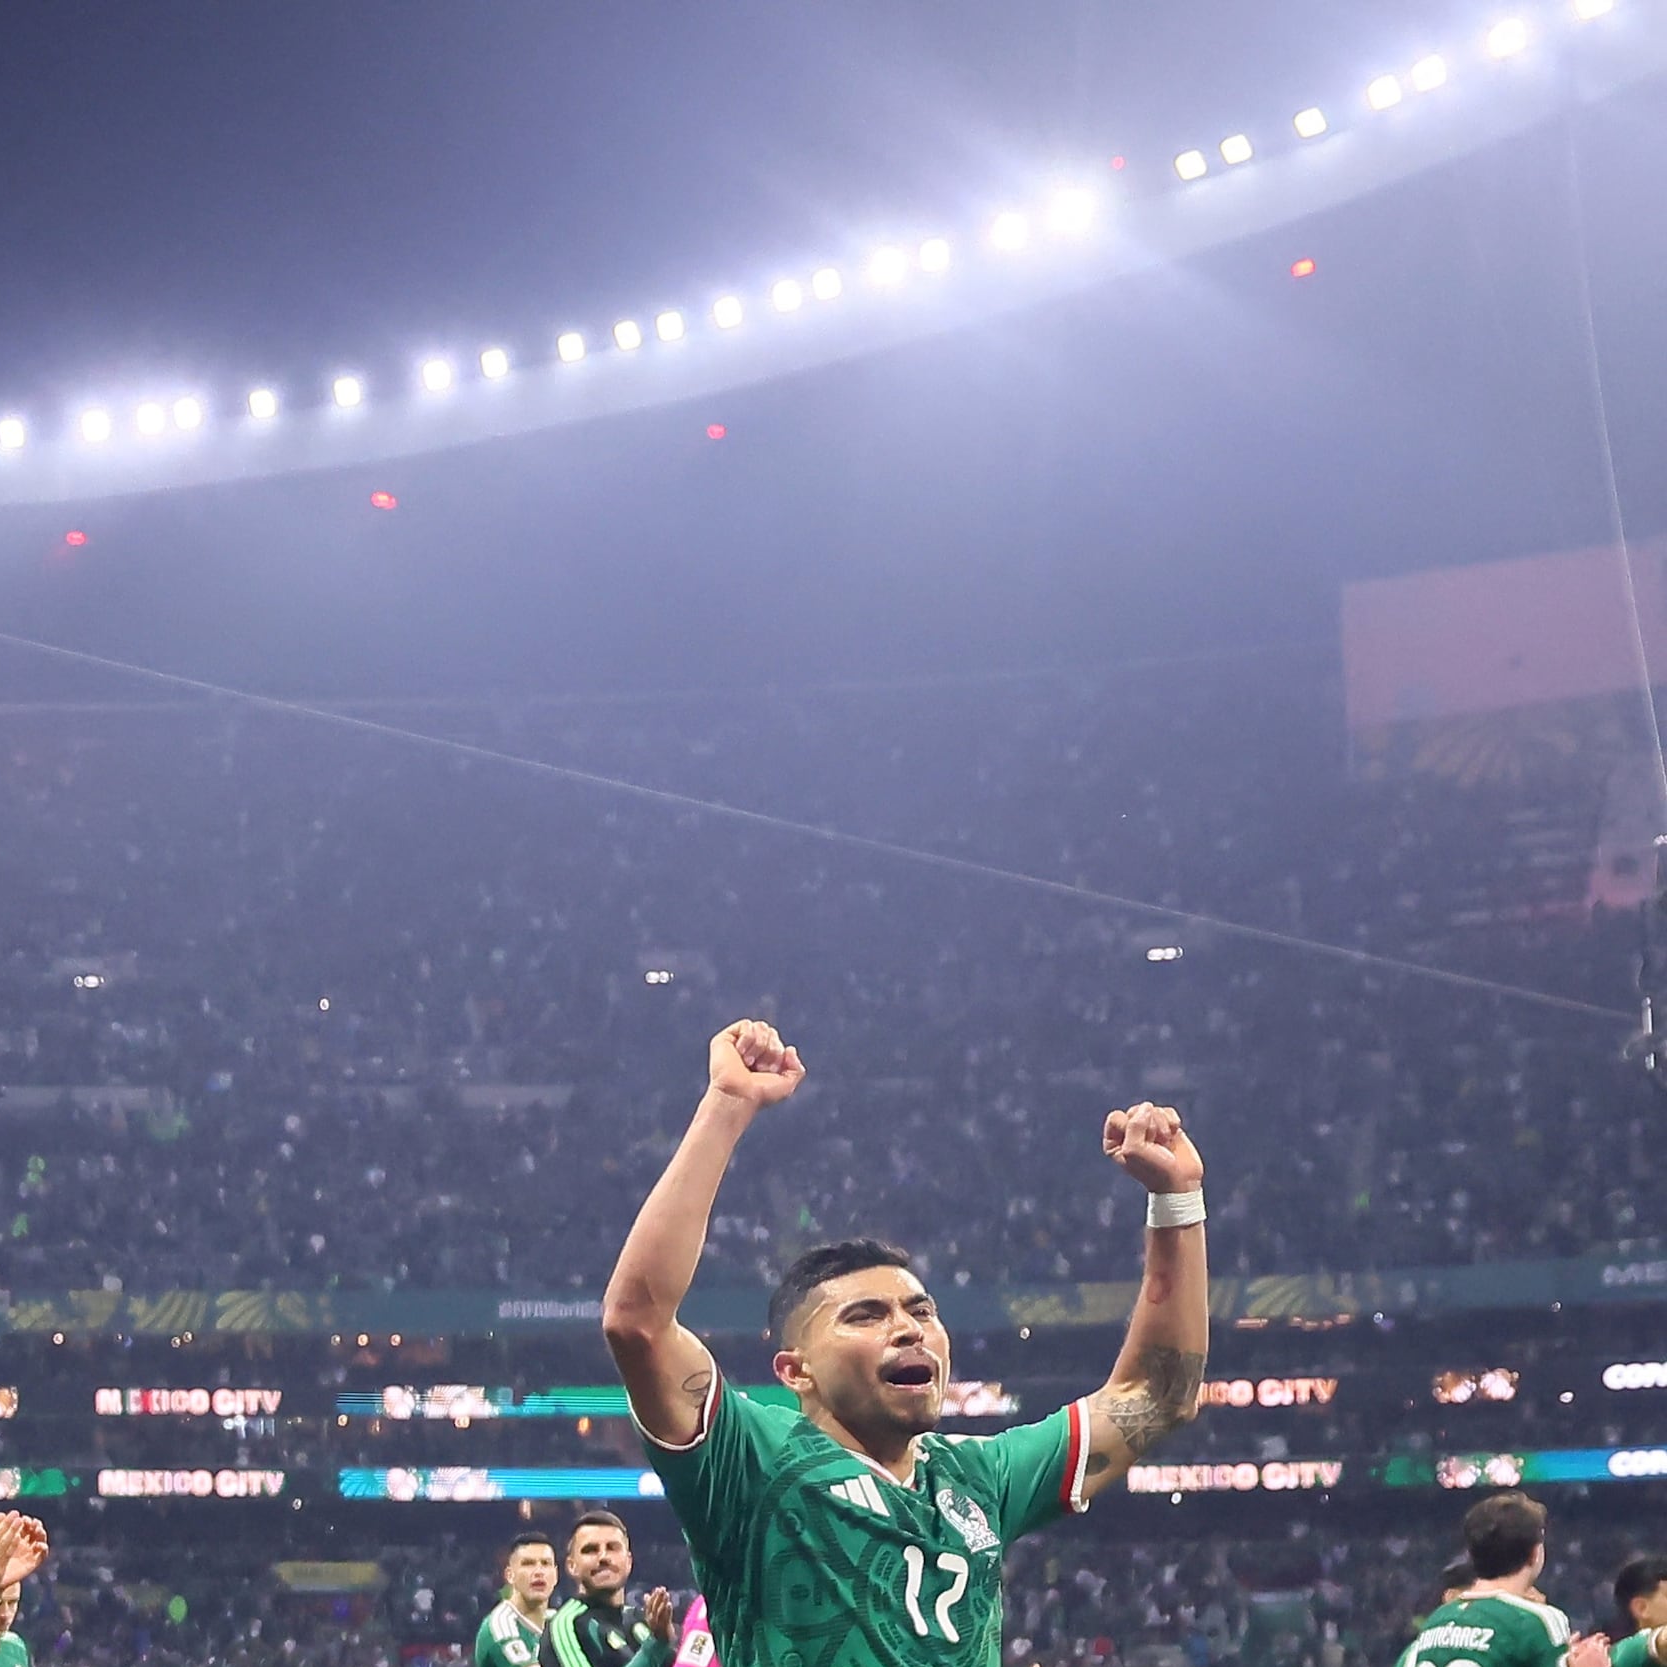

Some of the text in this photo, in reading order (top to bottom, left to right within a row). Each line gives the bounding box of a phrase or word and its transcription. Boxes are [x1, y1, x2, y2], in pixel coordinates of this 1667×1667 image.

[94, 1387, 283, 1417] MEXICO CITY
[1256, 1378, 1339, 1407] CITY
[97, 1469, 286, 1498] MEXICO CITY
[1127, 1461, 1343, 1493] MEXICO CITY
